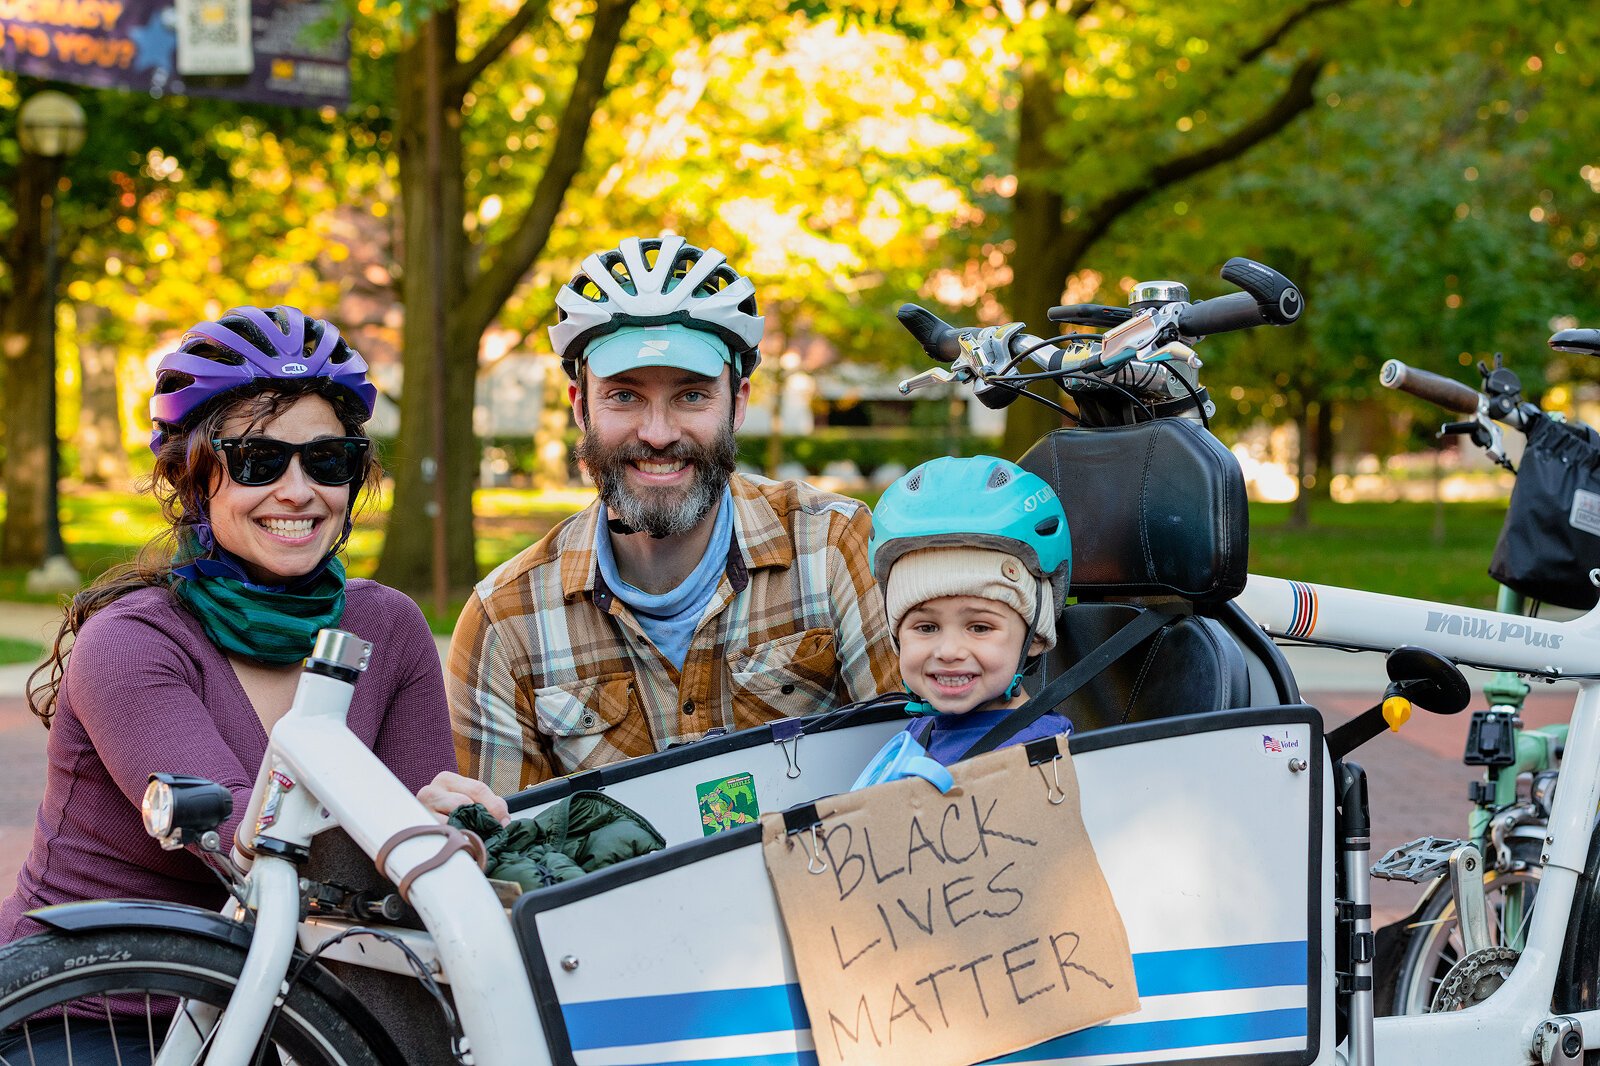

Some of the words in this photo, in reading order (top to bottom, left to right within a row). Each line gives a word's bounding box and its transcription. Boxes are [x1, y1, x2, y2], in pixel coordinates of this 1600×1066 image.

[1425, 611, 1497, 639] Milk
[1498, 622, 1564, 649] Plus
[1280, 740, 1299, 748] Voted
[821, 795, 1037, 901] BLACK
[831, 862, 1023, 970] LIVES
[64, 950, 132, 970] 47-406
[828, 932, 1113, 1061] MATTER
